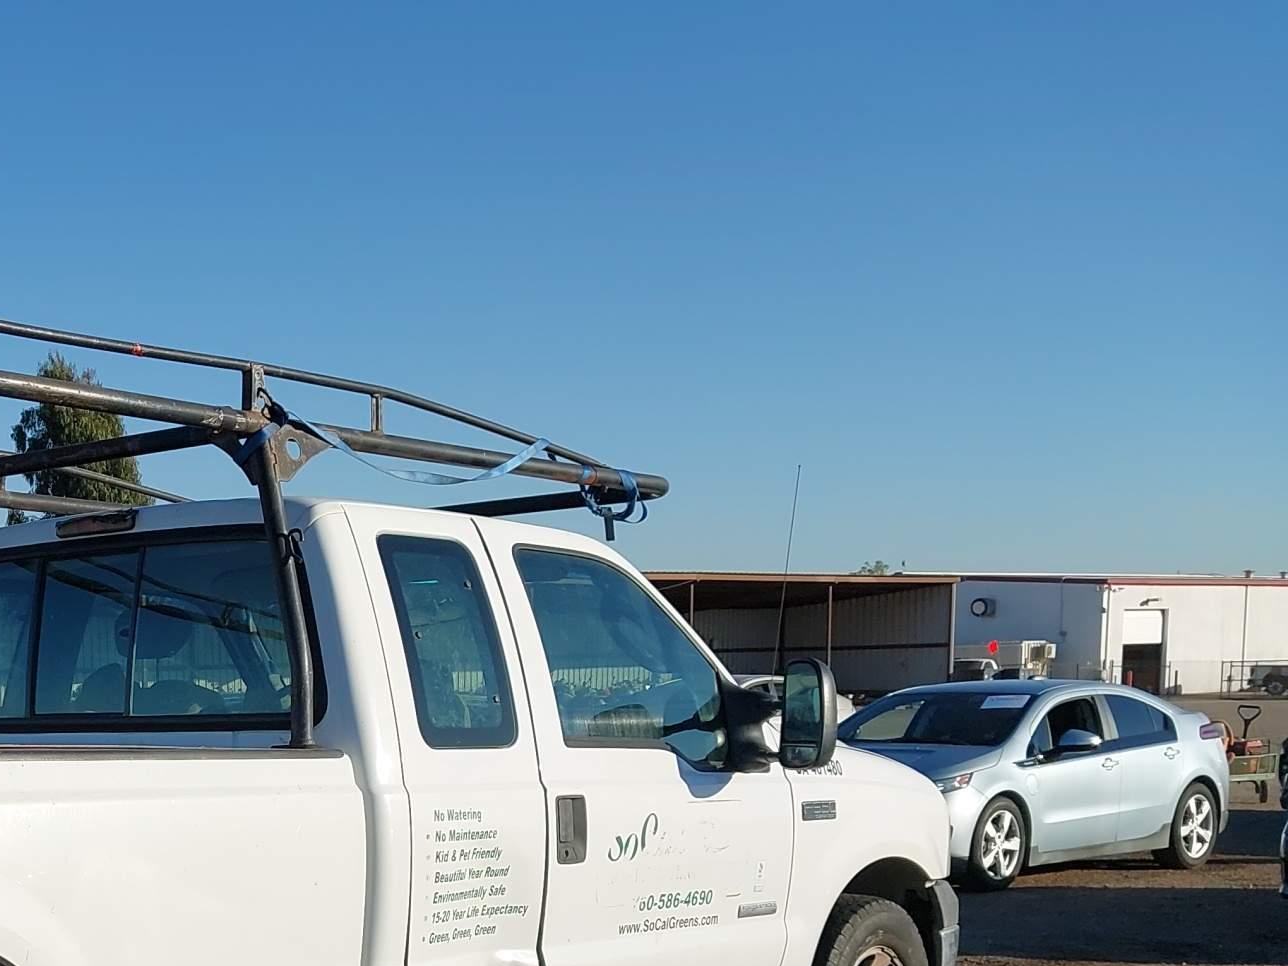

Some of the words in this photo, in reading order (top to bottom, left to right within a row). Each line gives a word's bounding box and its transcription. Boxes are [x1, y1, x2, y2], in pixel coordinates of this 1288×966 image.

[434, 809, 445, 822] No
[447, 808, 482, 823] Watering
[435, 830, 447, 843] No
[448, 828, 498, 842] Maintenance
[435, 850, 449, 863] Kid
[451, 849, 457, 862] &
[459, 848, 471, 862] Pet
[472, 846, 503, 861] Friendly
[434, 867, 467, 884] Beautiful
[468, 867, 484, 880] Year
[484, 865, 511, 879] Round
[432, 886, 487, 905] Environmentally
[488, 884, 506, 898] Safe
[432, 910, 451, 924] 15-20
[452, 907, 467, 921] Year
[467, 905, 480, 919] Life
[480, 903, 528, 918] Expectancy
[429, 931, 451, 945] Green,
[452, 928, 473, 941] Green,
[474, 924, 497, 937] Green
[618, 914, 719, 935] www.SoCalGreens.com
